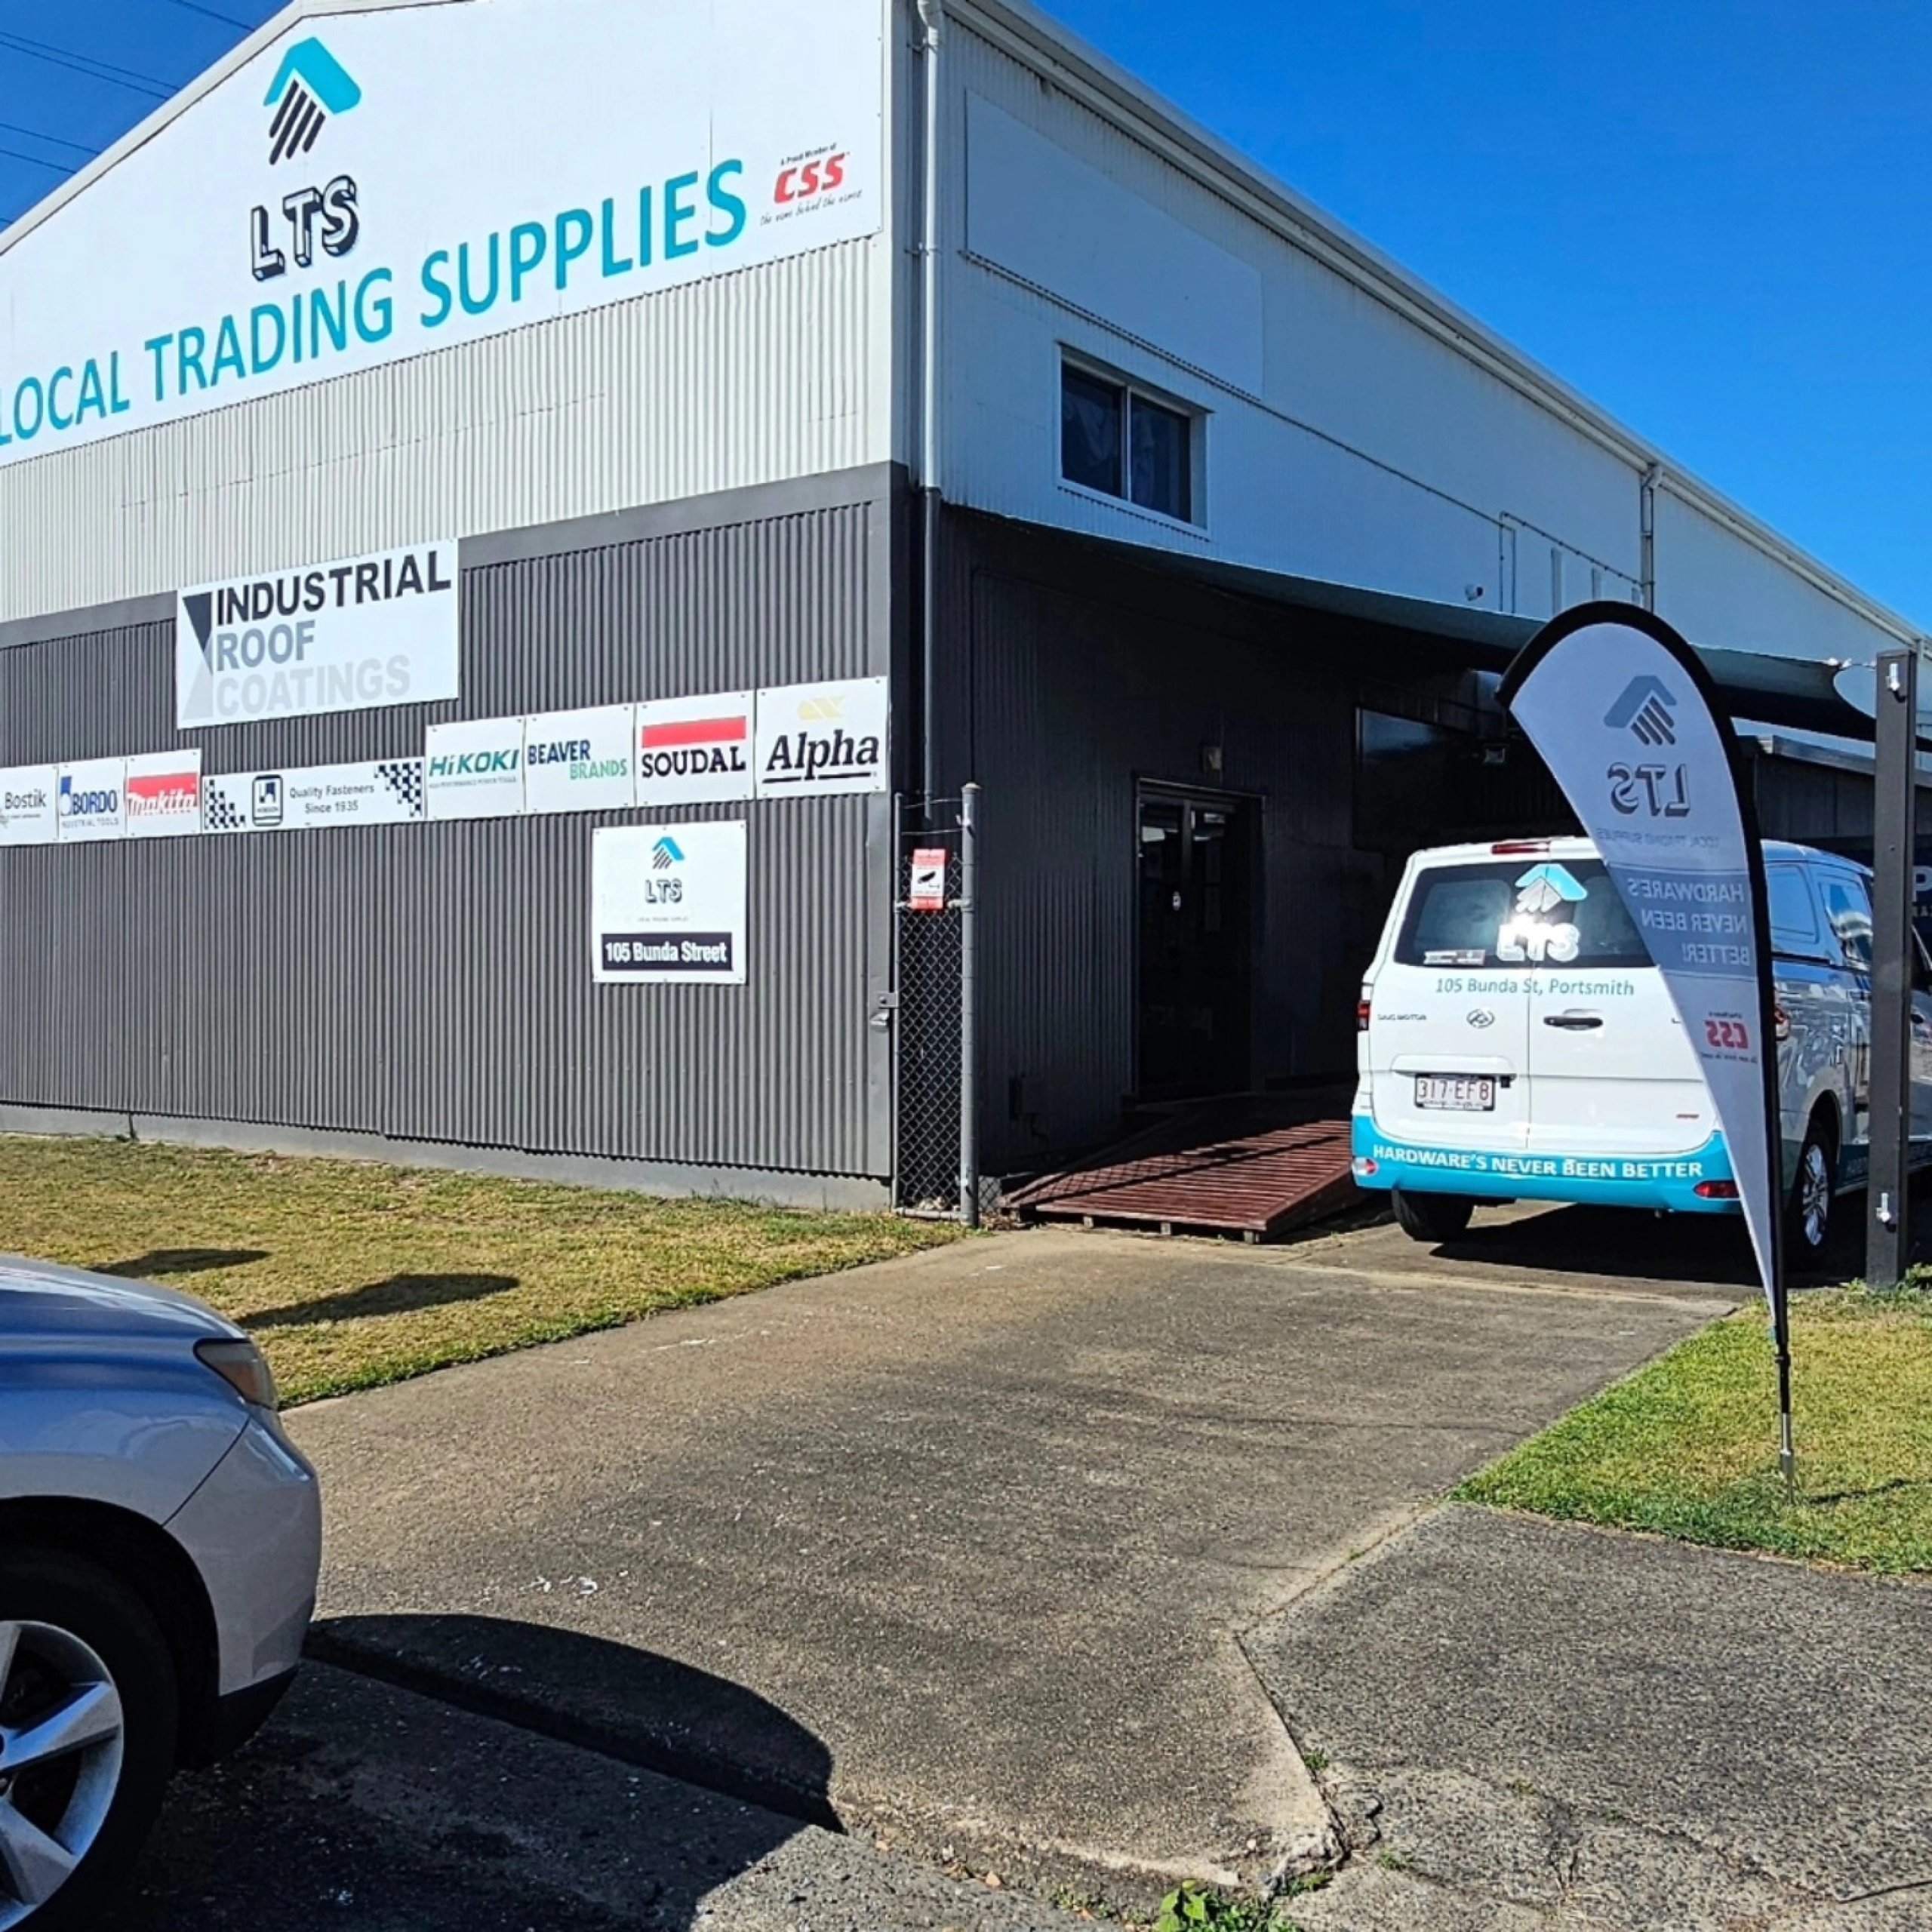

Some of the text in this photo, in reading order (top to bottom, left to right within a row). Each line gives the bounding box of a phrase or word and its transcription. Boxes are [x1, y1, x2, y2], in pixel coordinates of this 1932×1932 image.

[774, 152, 845, 204] CSS
[251, 174, 358, 282] LTS
[144, 267, 392, 401] TRADING
[420, 158, 747, 328] SUPPLIES
[216, 549, 452, 626] INDUSTRIAL
[216, 620, 315, 672] ROOF
[216, 654, 411, 717] COATINGS
[429, 749, 519, 777] HiKOKI
[528, 740, 591, 765] BEAVER
[642, 746, 746, 778] SOUDAL
[765, 729, 879, 780] Alpha
[570, 758, 628, 780] BRANDS
[5, 788, 48, 809] Bostik
[73, 789, 118, 816] BORDO
[289, 783, 375, 799] Quality Fasteners
[305, 801, 331, 814] Since
[645, 878, 682, 904] LTS
[605, 940, 728, 963] 105 Bunda Street
[1435, 977, 1635, 996] 105 Bunda St, Portsmith
[1373, 1143, 1703, 1178] HARDWARE'S NEVER BEEN BETTER
